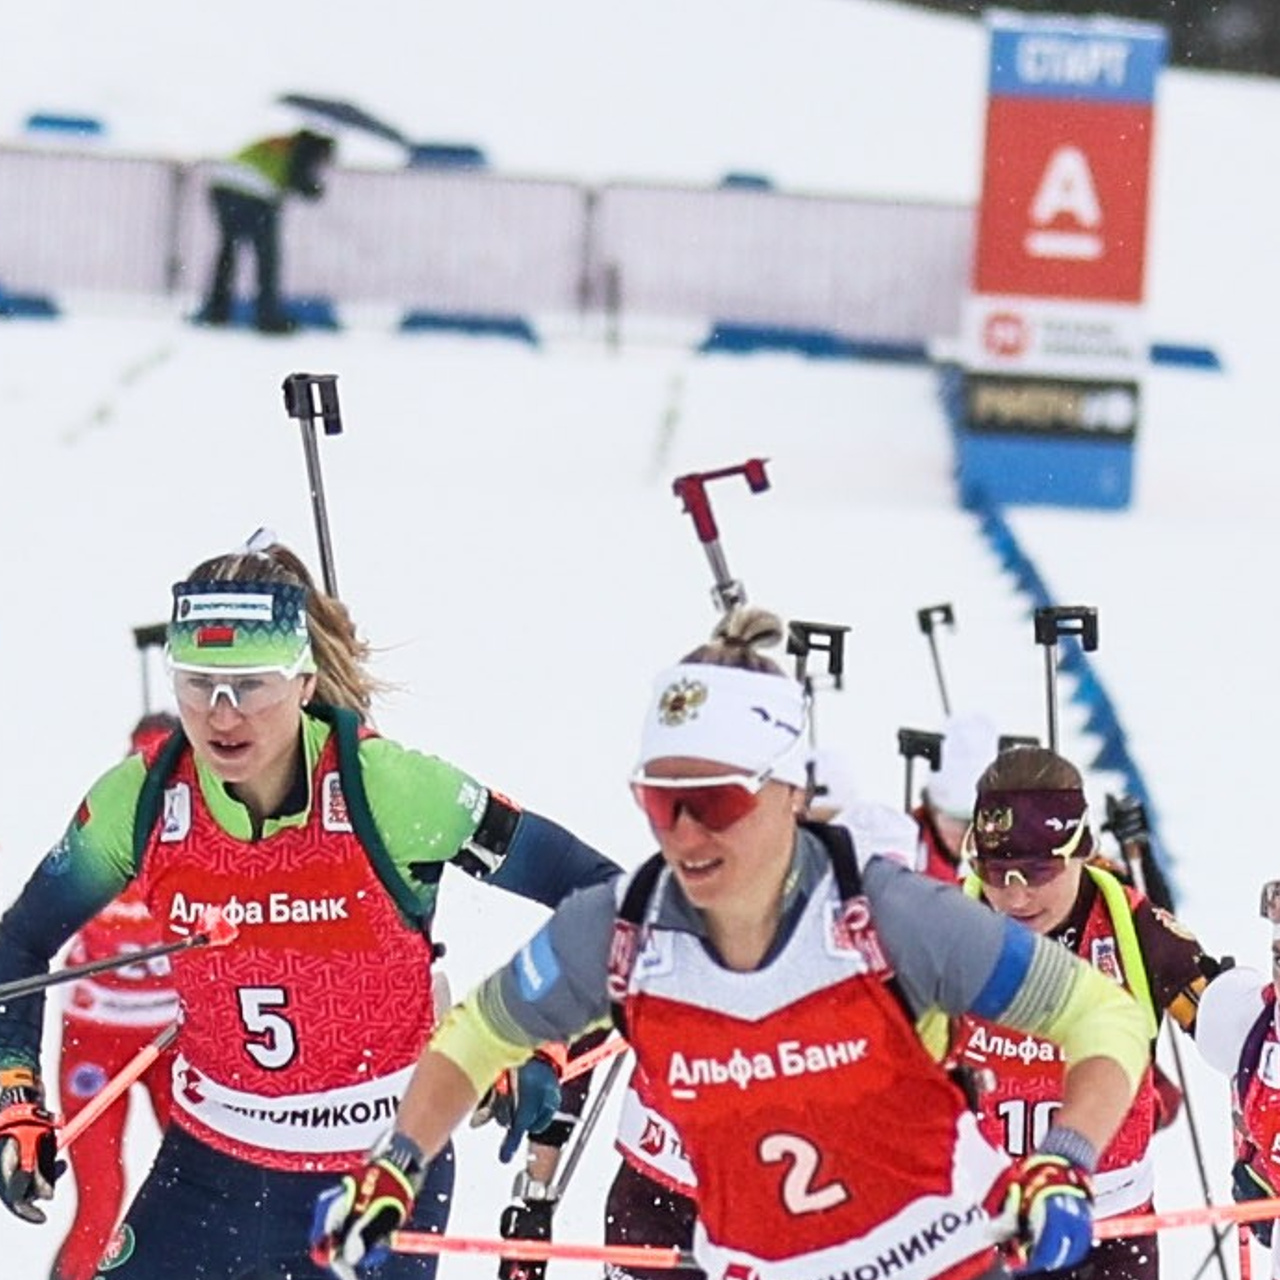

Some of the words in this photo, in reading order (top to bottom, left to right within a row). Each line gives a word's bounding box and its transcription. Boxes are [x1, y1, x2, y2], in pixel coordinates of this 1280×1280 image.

[269, 893, 349, 924] Банк
[237, 985, 297, 1070] 5
[968, 1027, 1054, 1066] Альфа
[668, 1050, 776, 1091] Альфа
[777, 1038, 868, 1076] Банк
[757, 1131, 851, 1216] 2
